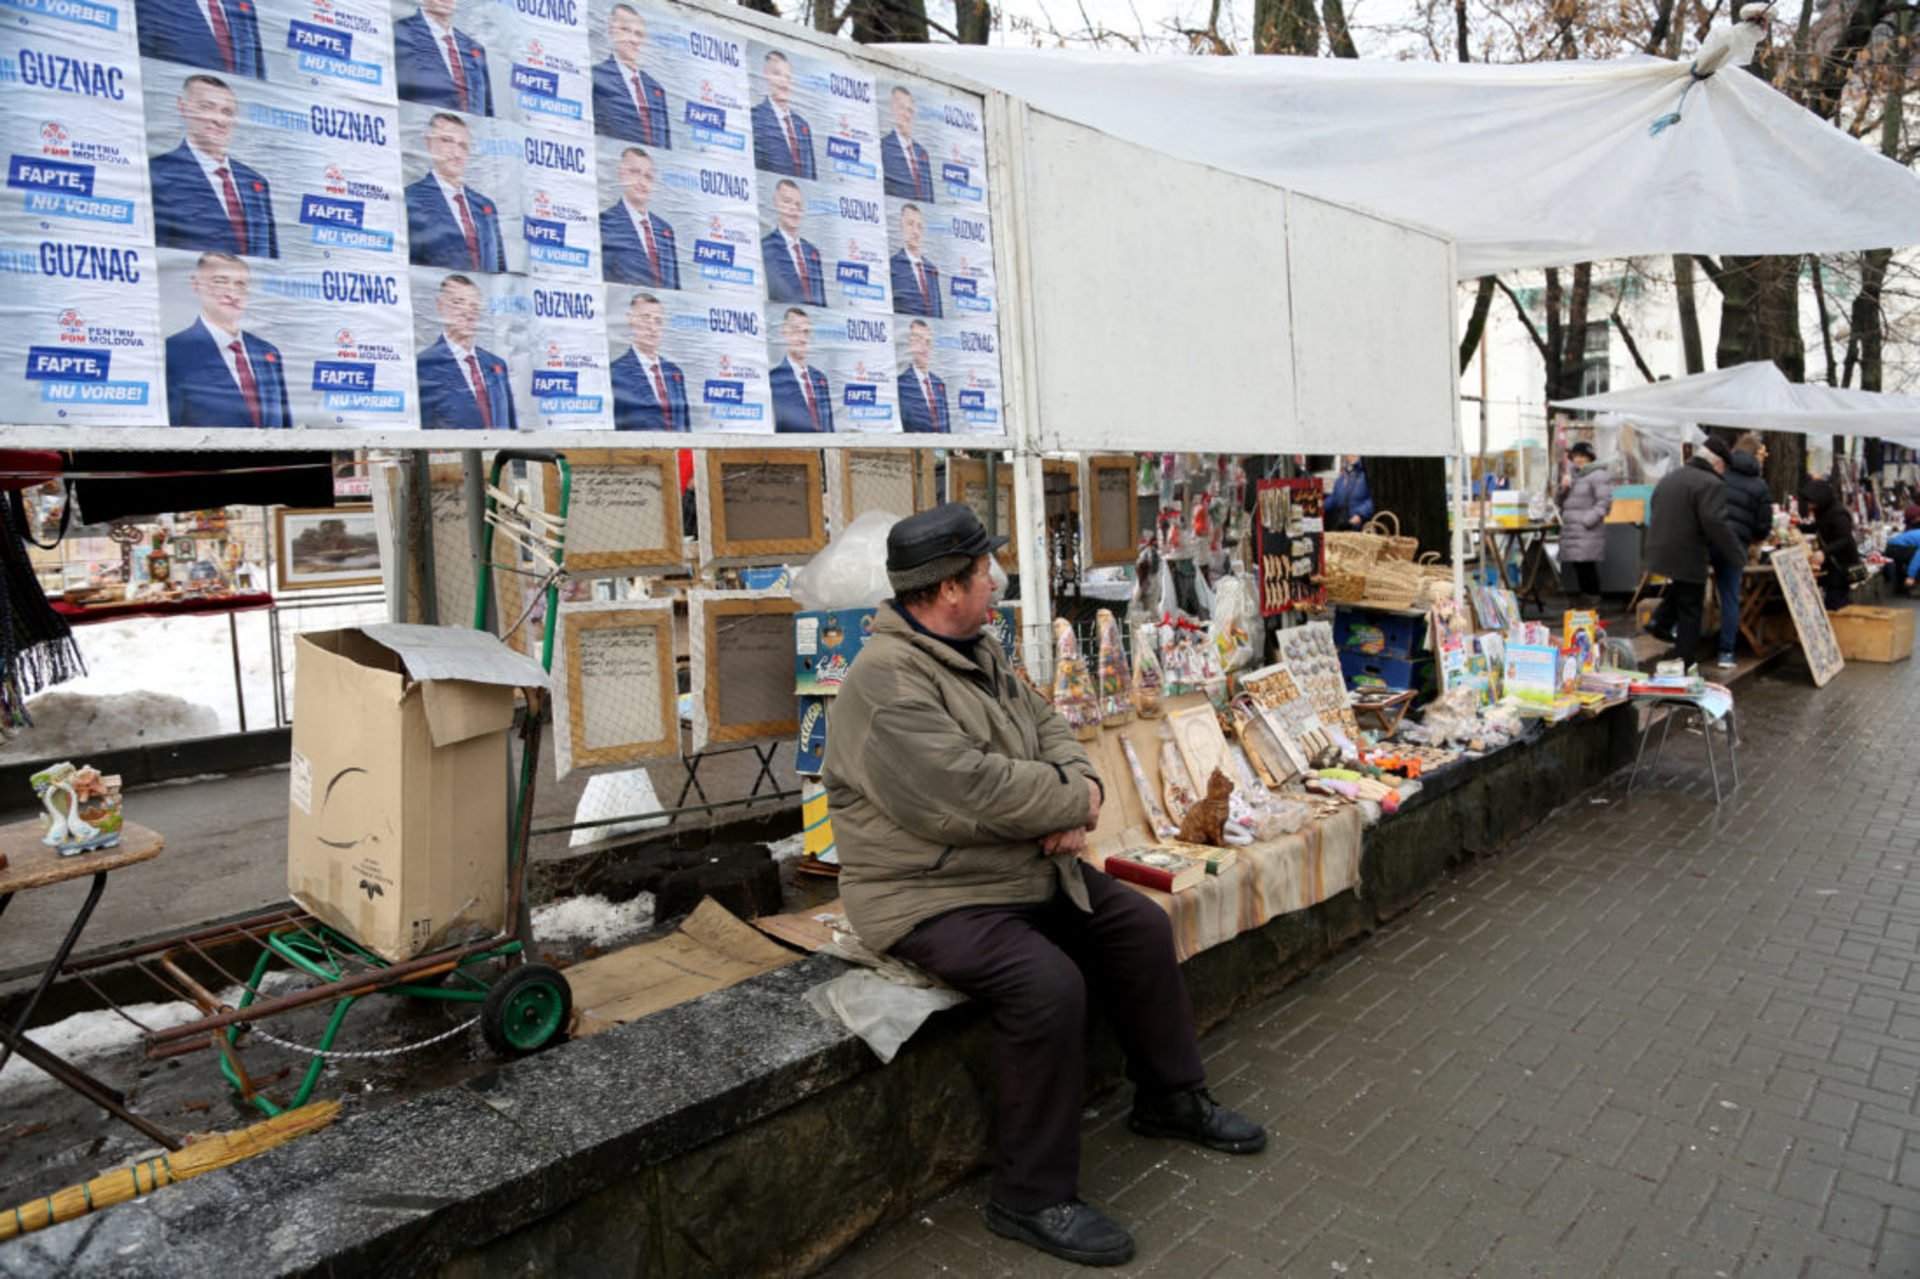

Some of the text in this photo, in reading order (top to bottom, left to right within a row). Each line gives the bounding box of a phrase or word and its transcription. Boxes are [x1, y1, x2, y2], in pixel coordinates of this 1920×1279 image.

[295, 28, 346, 56] FAPTE,
[690, 32, 739, 67] GUZNAC
[19, 48, 124, 101] GUZNAC
[311, 104, 387, 146] GUZNAC
[525, 136, 586, 174] GUZNAC
[19, 165, 87, 193] FAPTE,
[700, 163, 750, 201] GUZNAC
[31, 194, 129, 219] NU VORBE!
[308, 204, 358, 226] FAPTE,
[840, 196, 880, 224] GUZNAC
[40, 241, 140, 284] GUZNAC
[322, 270, 398, 305] GUZNAC
[534, 288, 594, 319] GUZNAC
[88, 327, 135, 338] PENTRU
[709, 302, 759, 336] GUZNAC
[847, 318, 888, 343] GUZNAC
[89, 336, 145, 347] MOLDOVA
[37, 356, 101, 377] FAPTE,
[320, 370, 369, 387] FAPTE,
[49, 384, 143, 401] NU VORBE!
[535, 378, 573, 393] FAPTE,
[328, 394, 351, 406] NU
